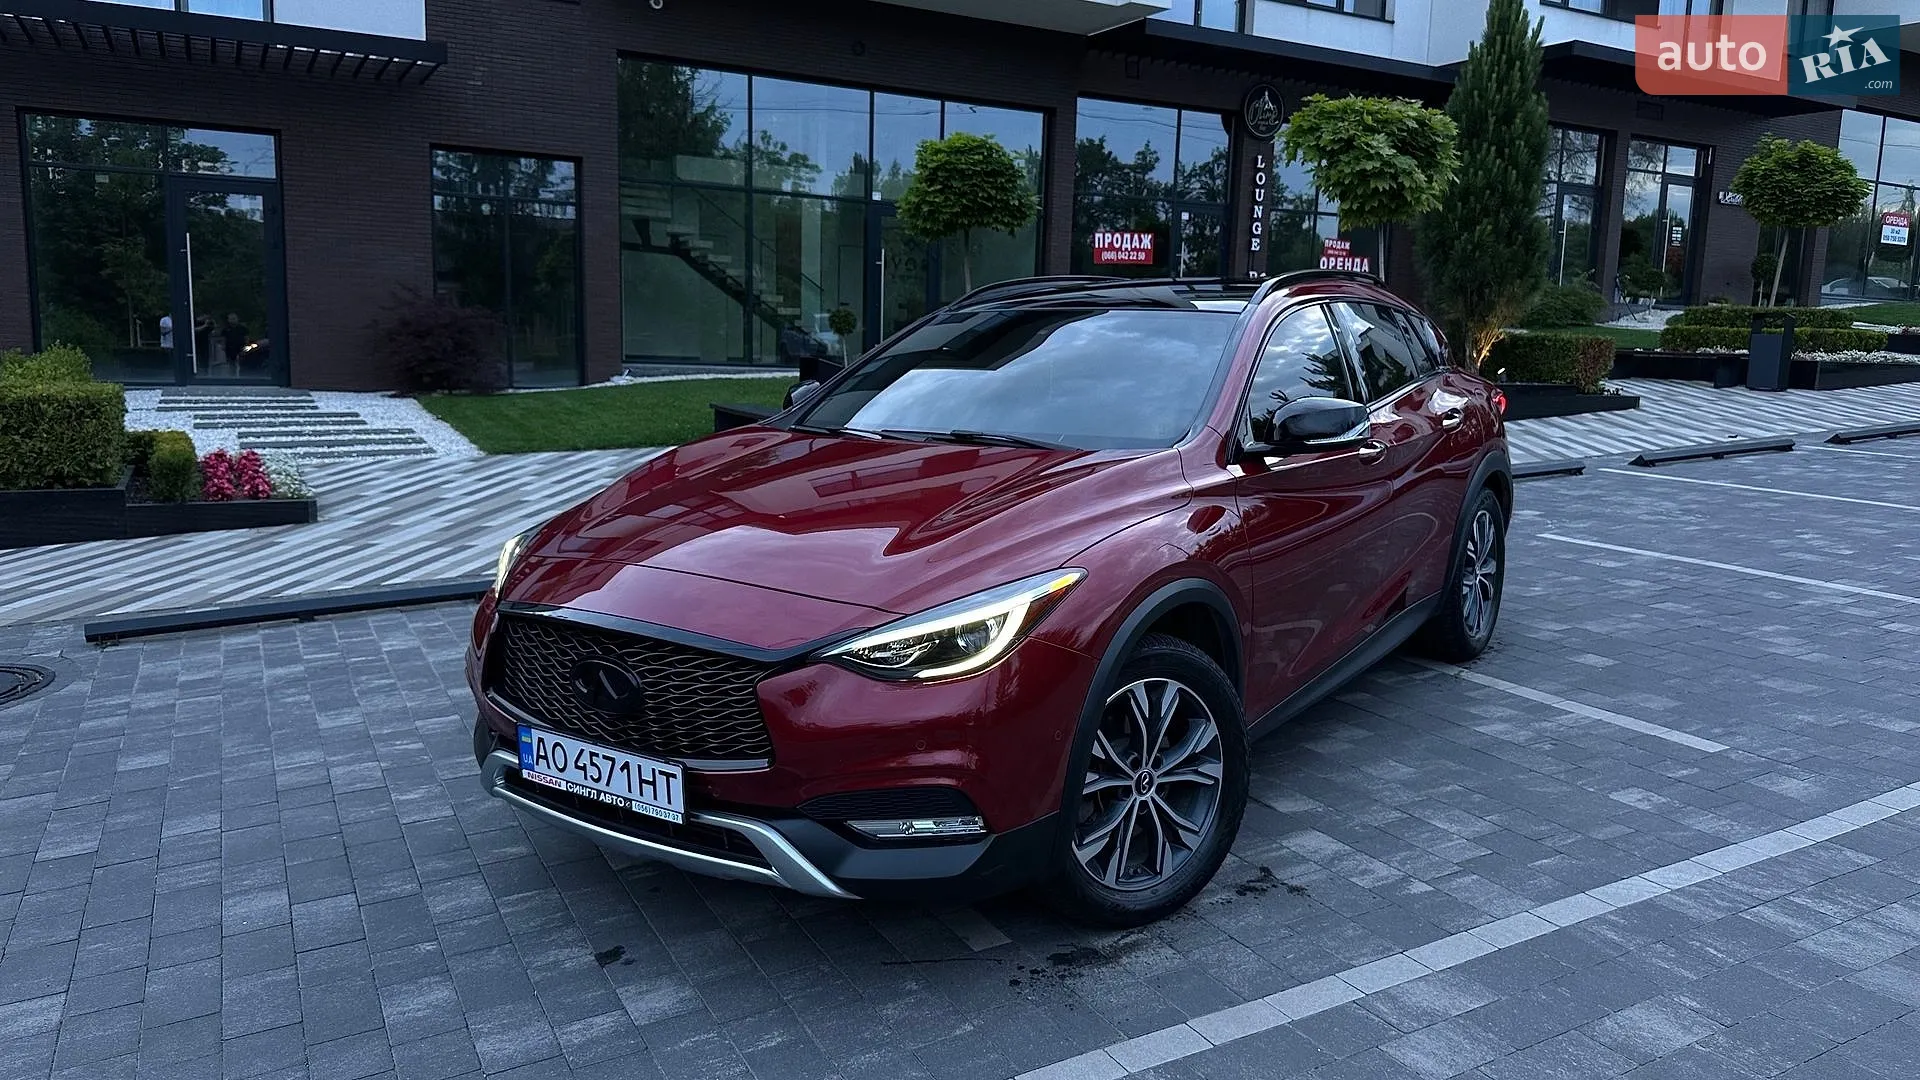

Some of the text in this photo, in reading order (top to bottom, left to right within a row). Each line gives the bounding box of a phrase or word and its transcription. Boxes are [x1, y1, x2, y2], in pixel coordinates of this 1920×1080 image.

[1250, 155, 1266, 251] LOUNGE
[1094, 232, 1153, 251] ПРОДАЖ
[1324, 239, 1351, 250] ПРОДАЖ
[1129, 251, 1137, 260] 22
[1320, 256, 1369, 273] ОРЕНДА
[522, 753, 534, 765] UA
[527, 771, 562, 788] NISSAN
[535, 737, 678, 805] AO 4571 HT
[567, 783, 625, 807] СИНГЛ АВТО
